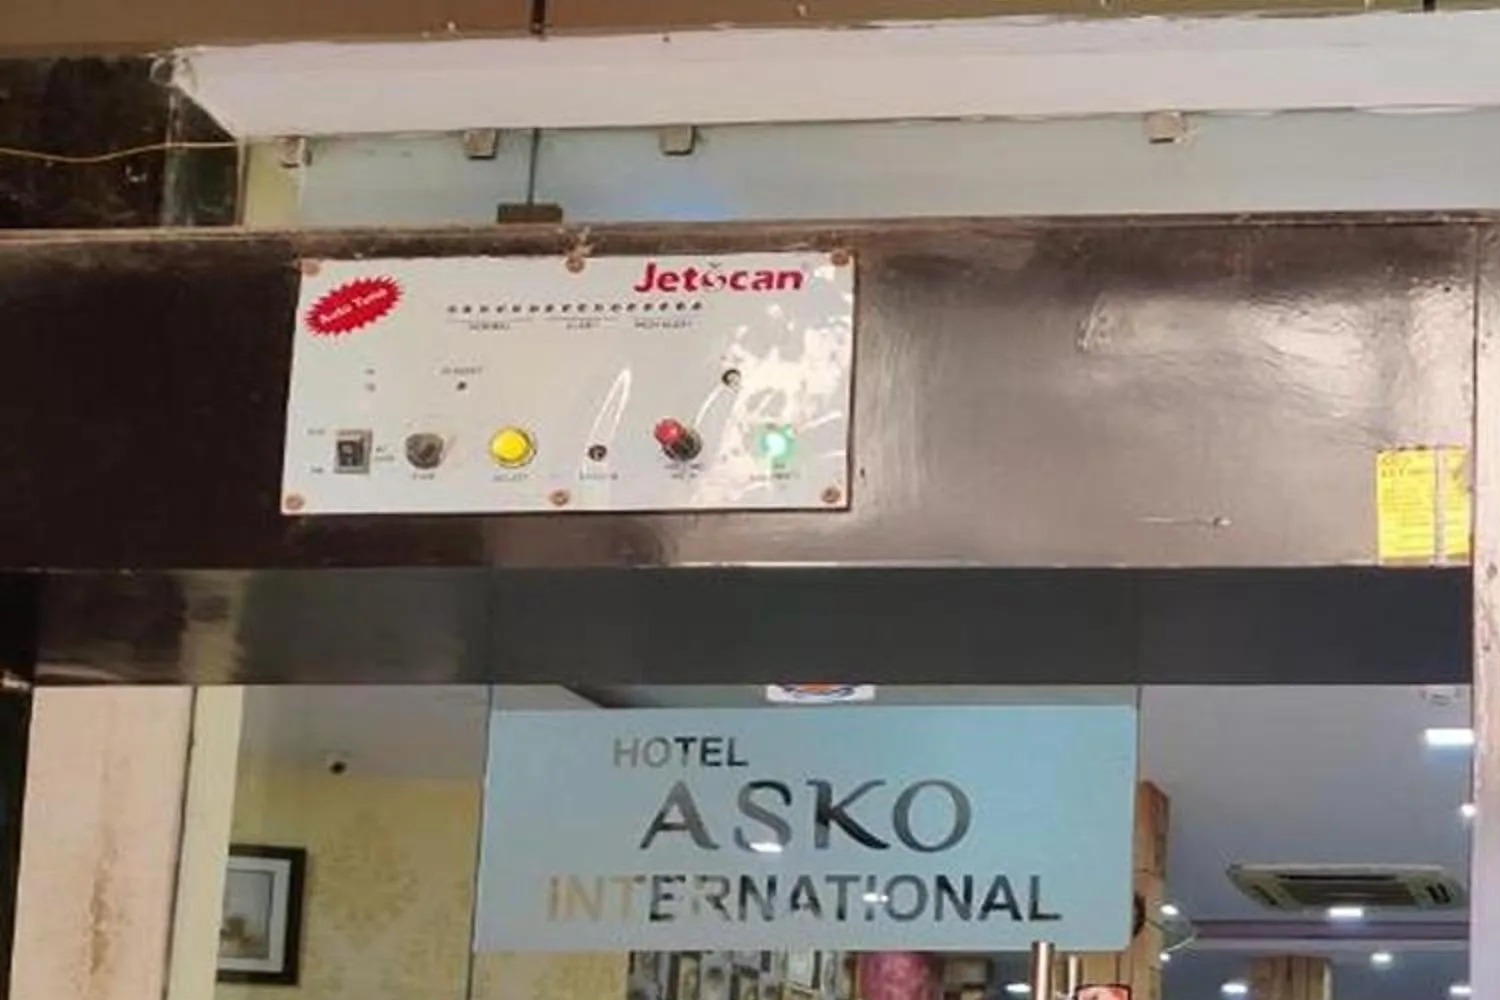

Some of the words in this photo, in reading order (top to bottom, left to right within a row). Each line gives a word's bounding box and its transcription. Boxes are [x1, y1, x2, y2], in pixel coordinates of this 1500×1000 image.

[612, 736, 748, 768] HOTEL
[639, 778, 972, 854] ASKO
[547, 874, 1062, 923] INTERNATIONAL
